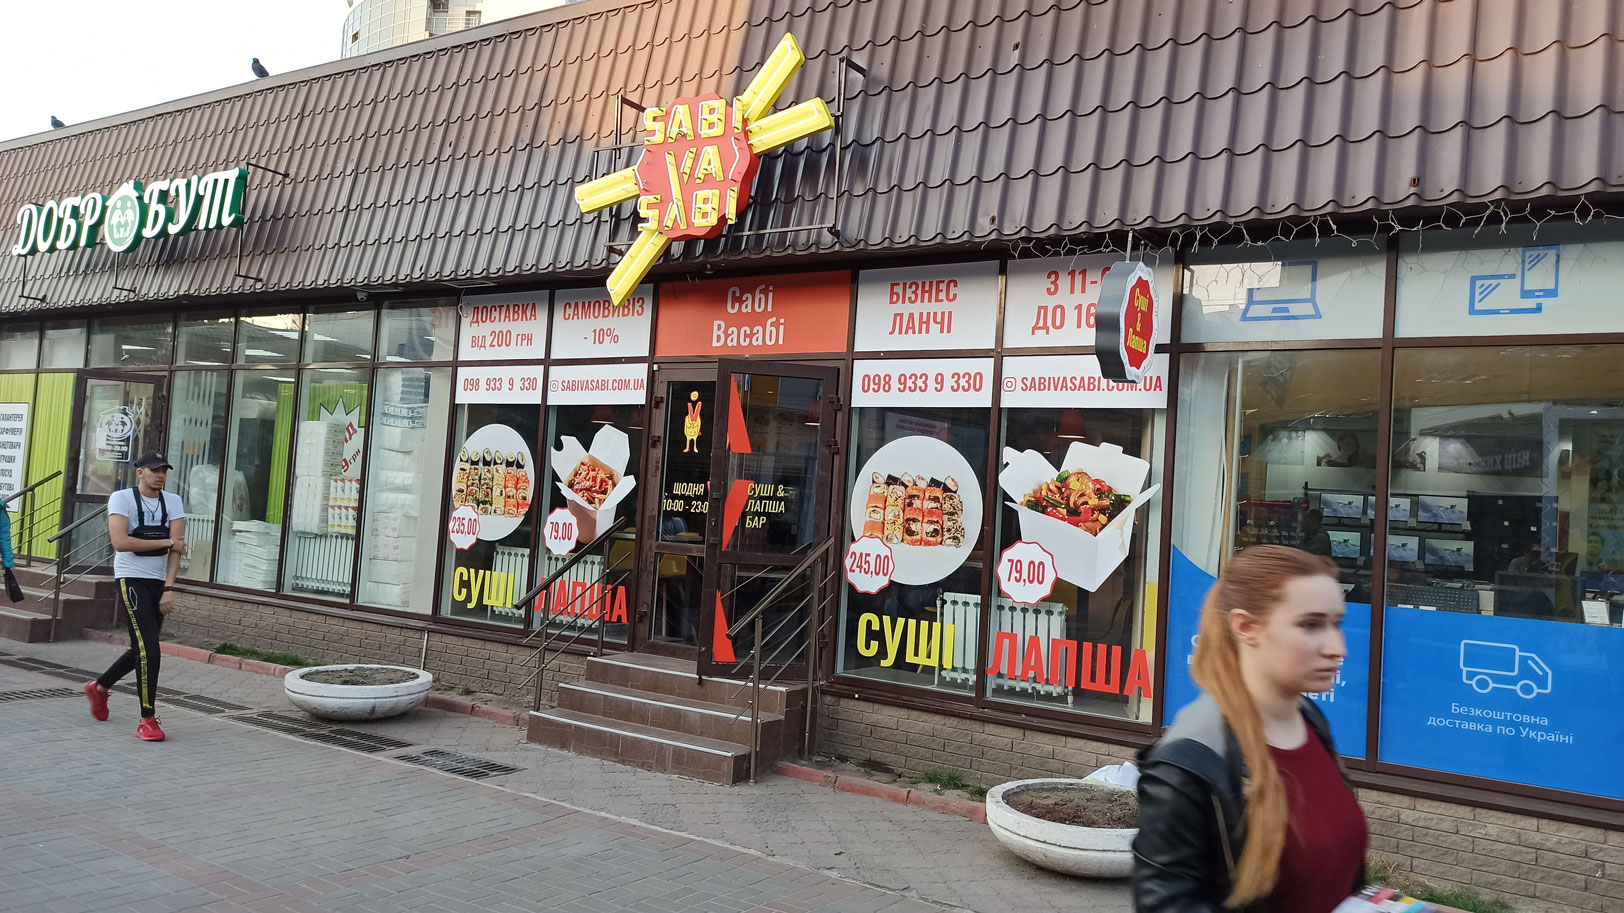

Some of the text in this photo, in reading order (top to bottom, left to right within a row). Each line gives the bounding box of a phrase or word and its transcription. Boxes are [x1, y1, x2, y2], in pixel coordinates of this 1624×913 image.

[643, 96, 743, 145] SABI
[665, 144, 725, 185] VA
[637, 186, 738, 231] SABI
[726, 286, 774, 314] Сабі
[889, 279, 958, 305] БІЗНЕС
[1134, 287, 1150, 312] Суші
[470, 302, 537, 328] ДОСТАВКА
[563, 297, 645, 321] САМОВИВІЗ
[1032, 302, 1096, 335] ДО 16
[711, 317, 785, 347] Васабі
[889, 310, 953, 335] ЛАНЧІ
[1136, 313, 1141, 332] &
[471, 330, 534, 350] ВІД 200 ГРН
[591, 328, 619, 345] 10%
[1127, 328, 1147, 354] Лапша
[463, 377, 538, 392] 098 933 9 330
[560, 377, 645, 392] SABIVASABI.COM.UA
[861, 371, 984, 393] 098 933 9 330
[0, 427, 23, 436] АРФУМЕРІЯ
[673, 482, 705, 497] ЩОДНЯ
[747, 483, 785, 497] СУШІ &
[663, 499, 684, 512] 10:00
[691, 501, 709, 513] 23:0
[745, 500, 785, 513] ЛАПША
[451, 516, 477, 536] 235,00
[550, 522, 573, 543] 79,00
[745, 515, 766, 528] БАР
[849, 552, 889, 578] 245,00
[1007, 558, 1045, 587] 79,00
[453, 567, 515, 609] СУШІ
[533, 577, 628, 624] ЛАПША
[857, 612, 955, 669] СУШІ
[986, 631, 1152, 699] ЛАПША
[1451, 702, 1548, 726] Безкоштовна
[1427, 716, 1573, 745] доставка по Україні
